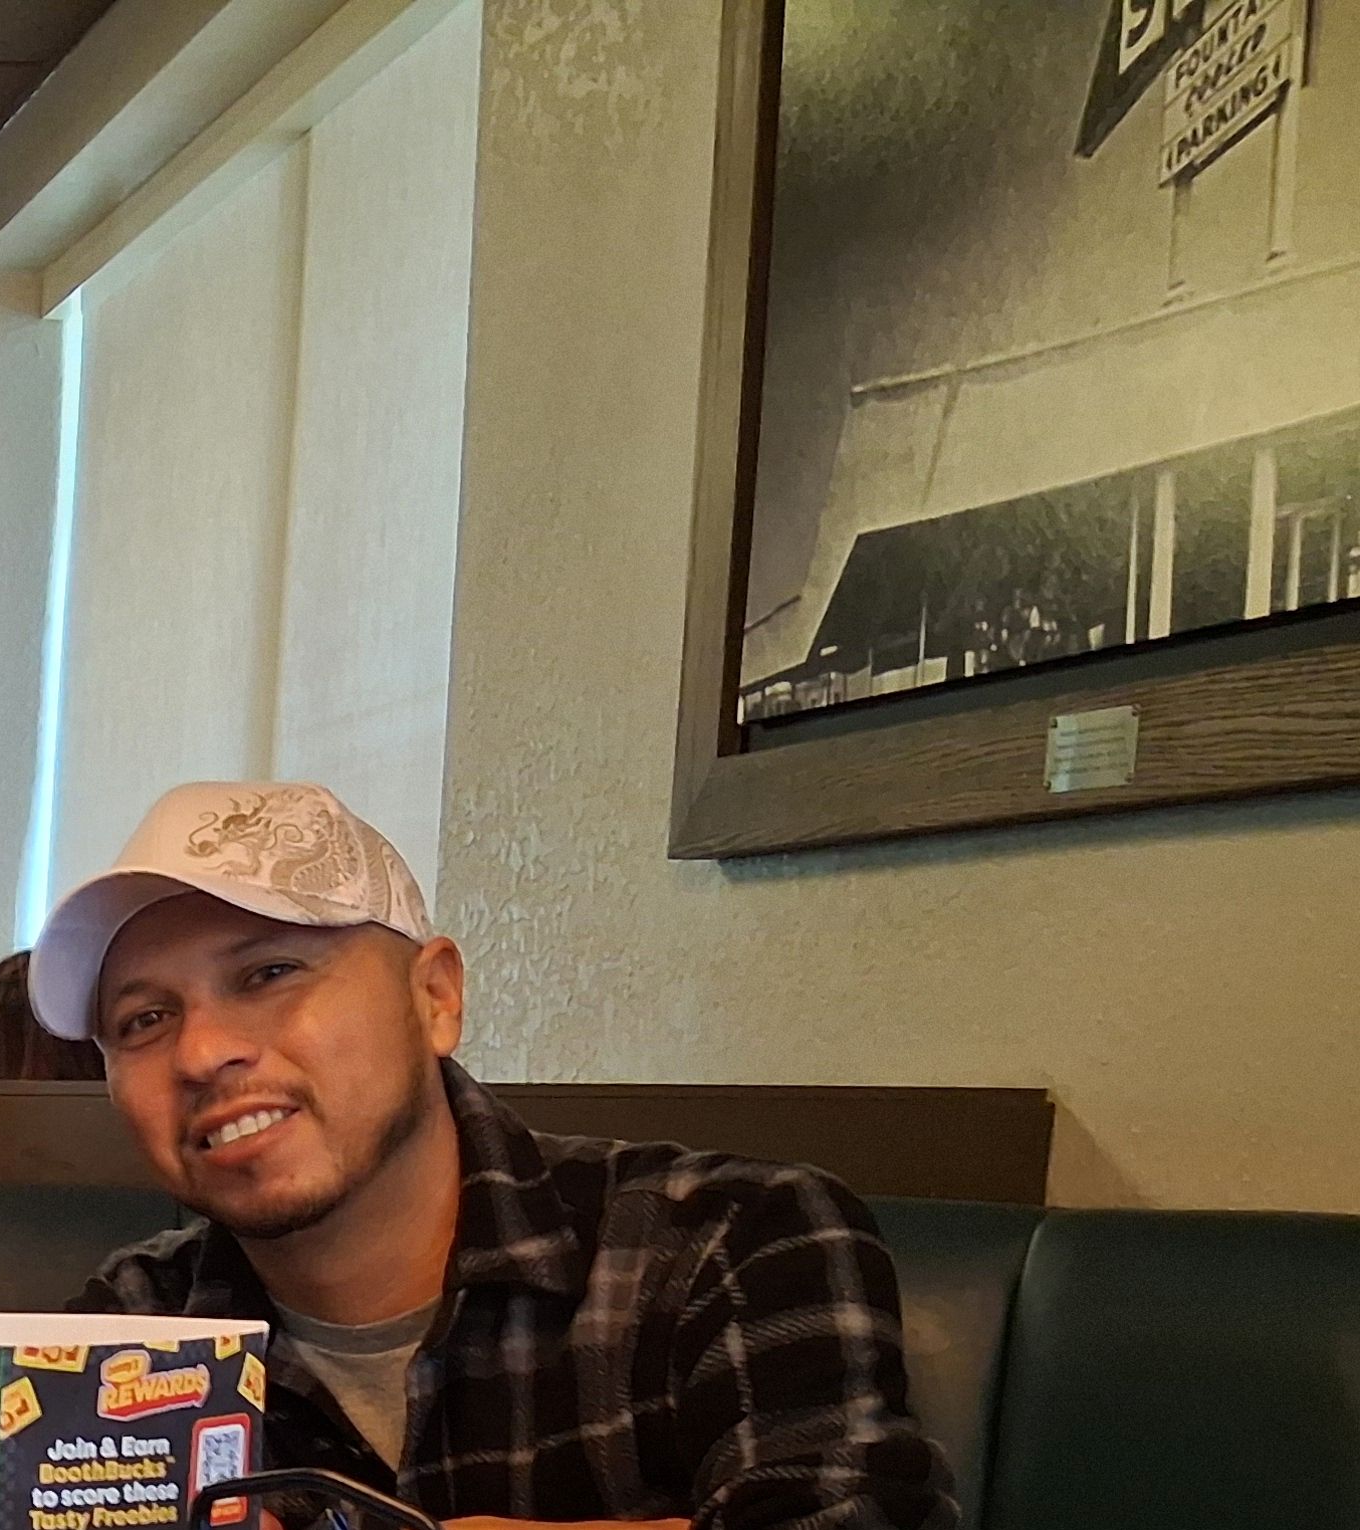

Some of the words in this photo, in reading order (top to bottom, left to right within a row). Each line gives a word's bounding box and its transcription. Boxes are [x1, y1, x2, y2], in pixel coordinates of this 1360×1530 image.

[1175, 0, 1261, 89] FOUNTA
[105, 1372, 206, 1411] REWARDS
[47, 1436, 97, 1461] Join
[99, 1436, 118, 1459] &
[121, 1435, 170, 1457] Earn
[32, 1487, 59, 1508] to
[60, 1486, 120, 1507] score
[123, 1480, 180, 1502] these
[92, 1502, 178, 1528] Freebies
